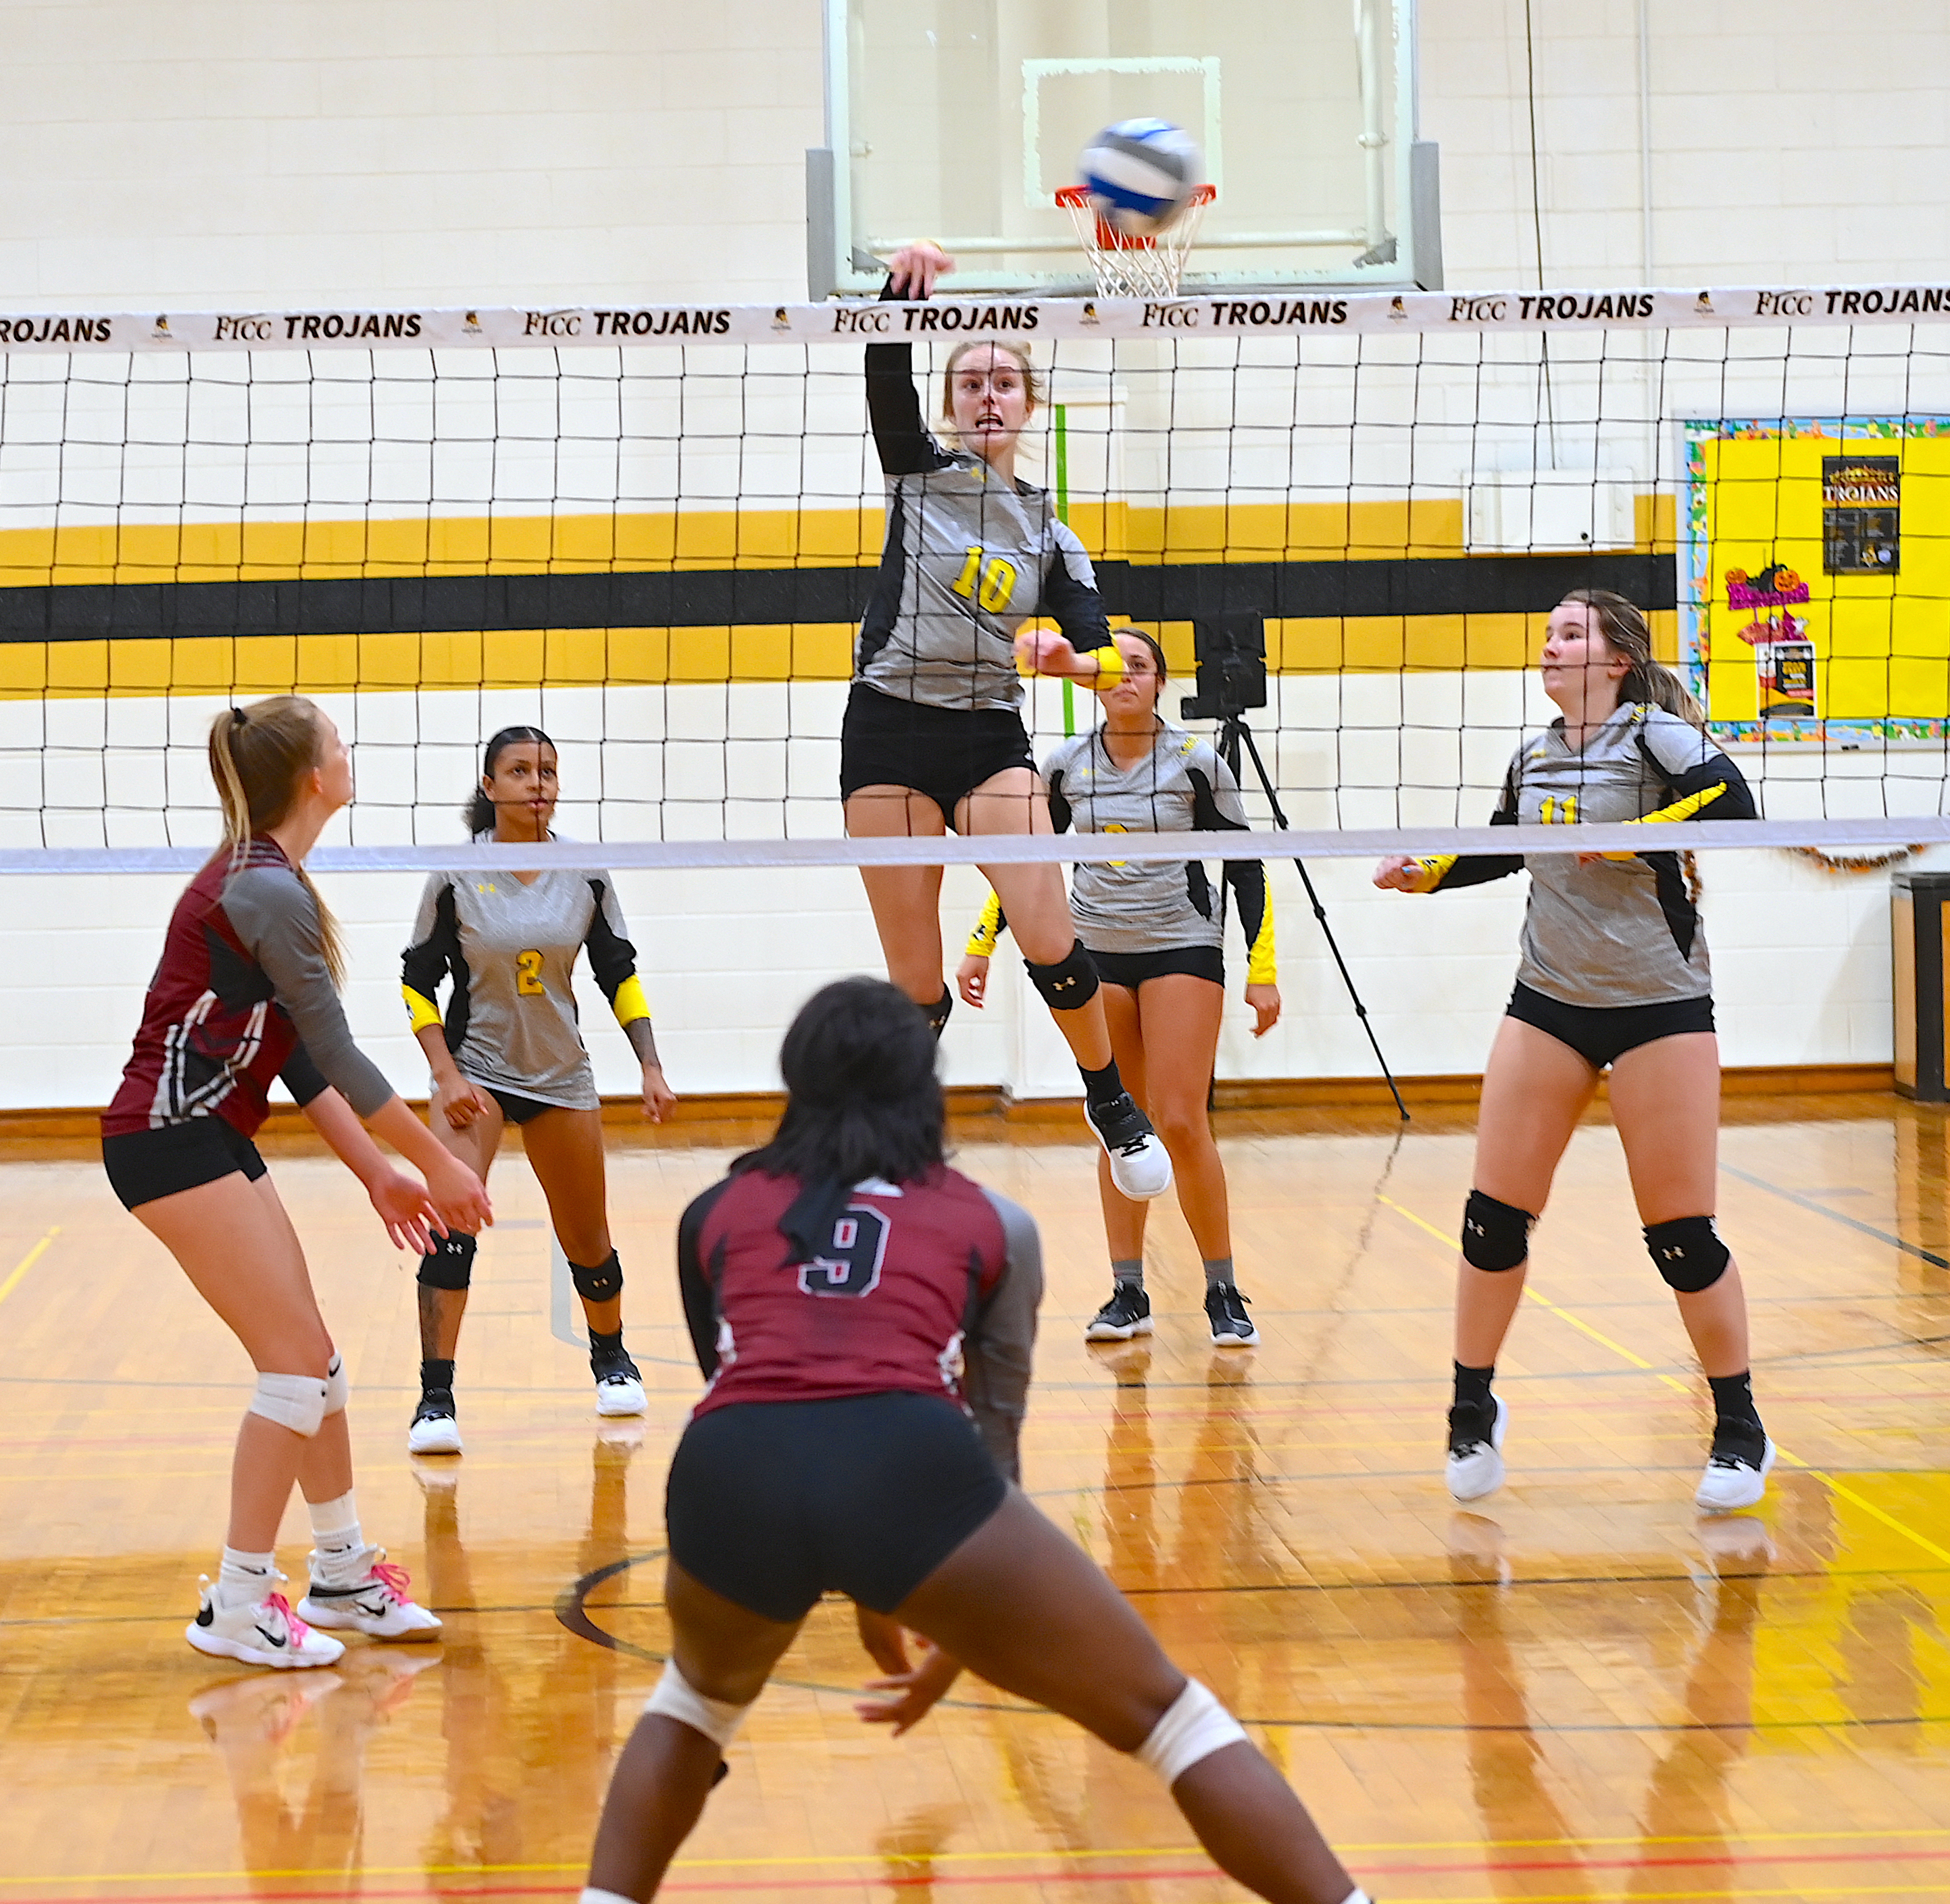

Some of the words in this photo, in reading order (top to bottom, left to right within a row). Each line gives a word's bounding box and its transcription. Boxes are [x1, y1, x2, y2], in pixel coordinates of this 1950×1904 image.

[903, 306, 1039, 330] TROJANS
[1211, 301, 1348, 326] TROJANS
[1518, 294, 1654, 320] TROJANS
[284, 314, 422, 339] TROJANS
[594, 310, 730, 335] TROJANS
[1824, 485, 1899, 501] TROJANS
[951, 545, 1016, 613] 10
[516, 949, 545, 996] 2
[797, 1203, 891, 1298] 9
